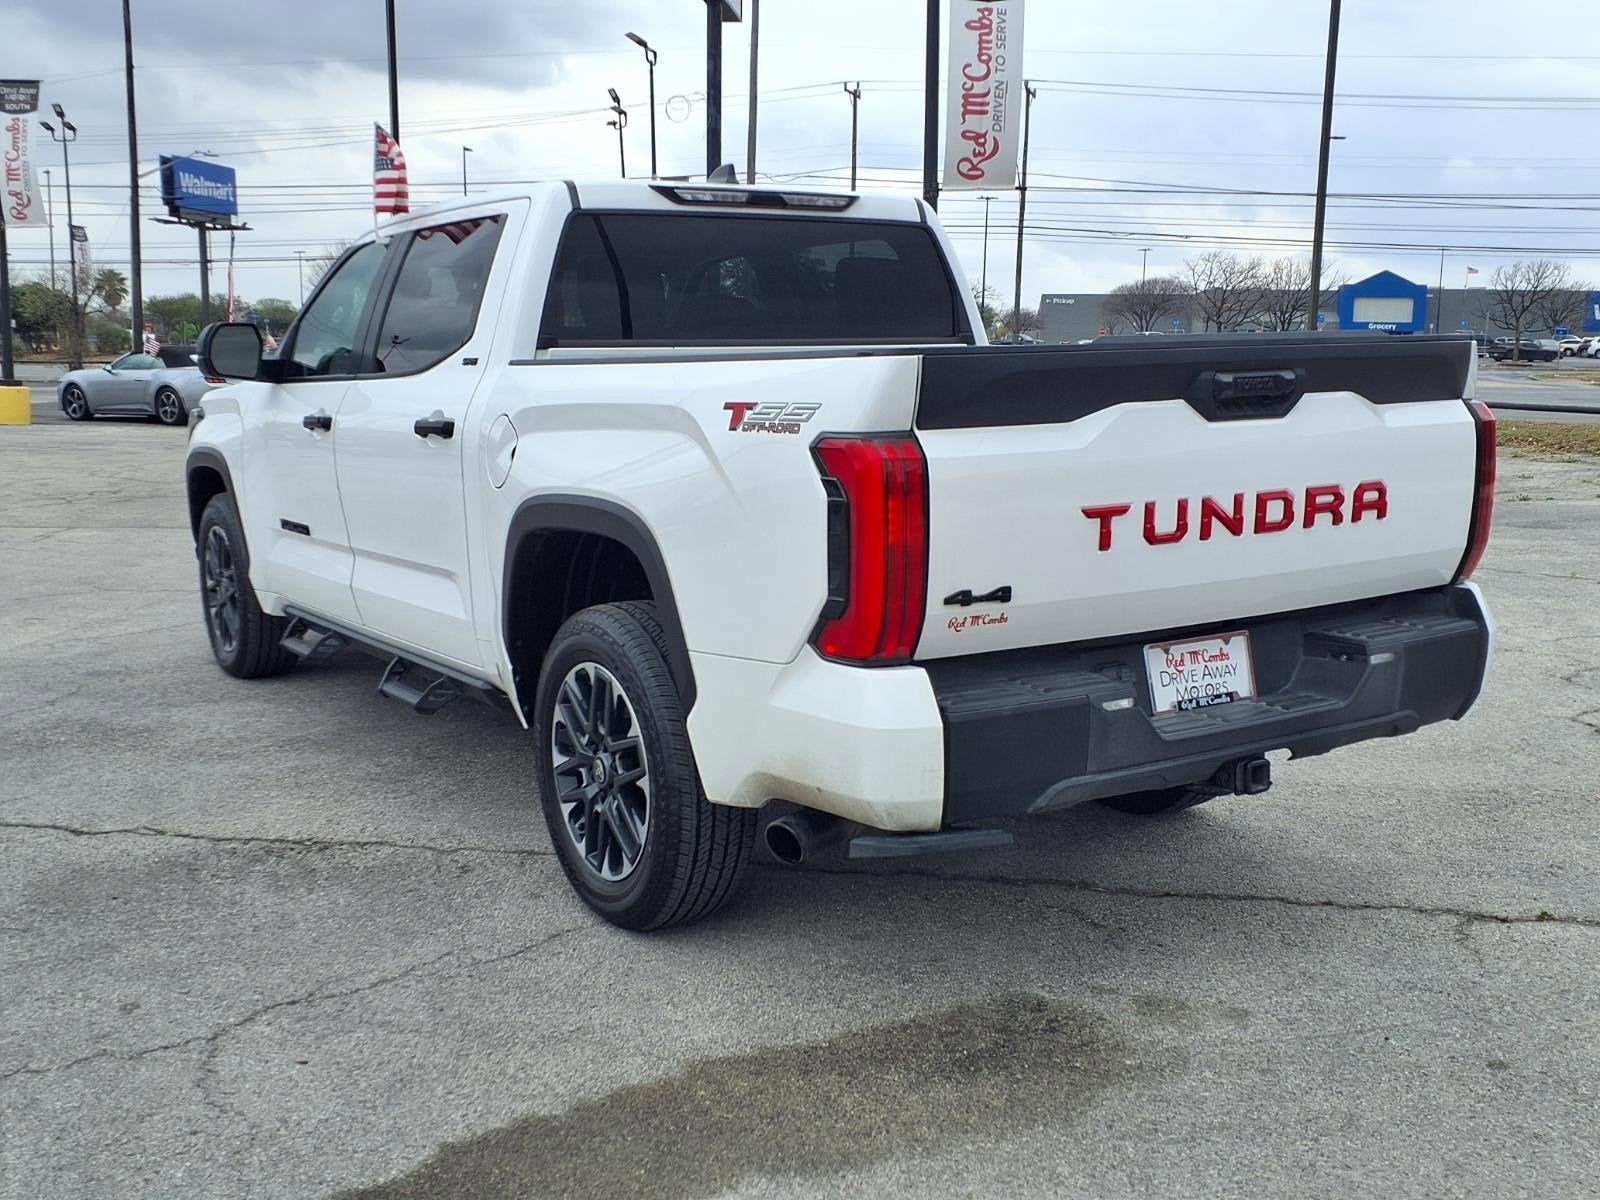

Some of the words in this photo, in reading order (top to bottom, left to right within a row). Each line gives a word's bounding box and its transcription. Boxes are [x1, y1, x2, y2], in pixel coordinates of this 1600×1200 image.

[996, 8, 1007, 50] SERVE
[961, 7, 993, 125] McCombs
[995, 55, 1006, 74] TO
[992, 80, 1005, 133] DRIVEN
[5, 117, 21, 187] McCombs
[957, 130, 1000, 180] Red
[179, 171, 234, 202] Walmart
[8, 190, 31, 220] Red
[1368, 323, 1397, 331] Grocery
[1081, 479, 1388, 551] TUNDRA
[948, 616, 967, 632] Red
[969, 612, 1008, 626] McCombs
[1160, 669, 1198, 687] DRIVE
[1202, 663, 1238, 681] AWAY
[1166, 652, 1185, 673] Red
[1186, 647, 1230, 665] McCombs
[1176, 681, 1229, 700] MOTORS
